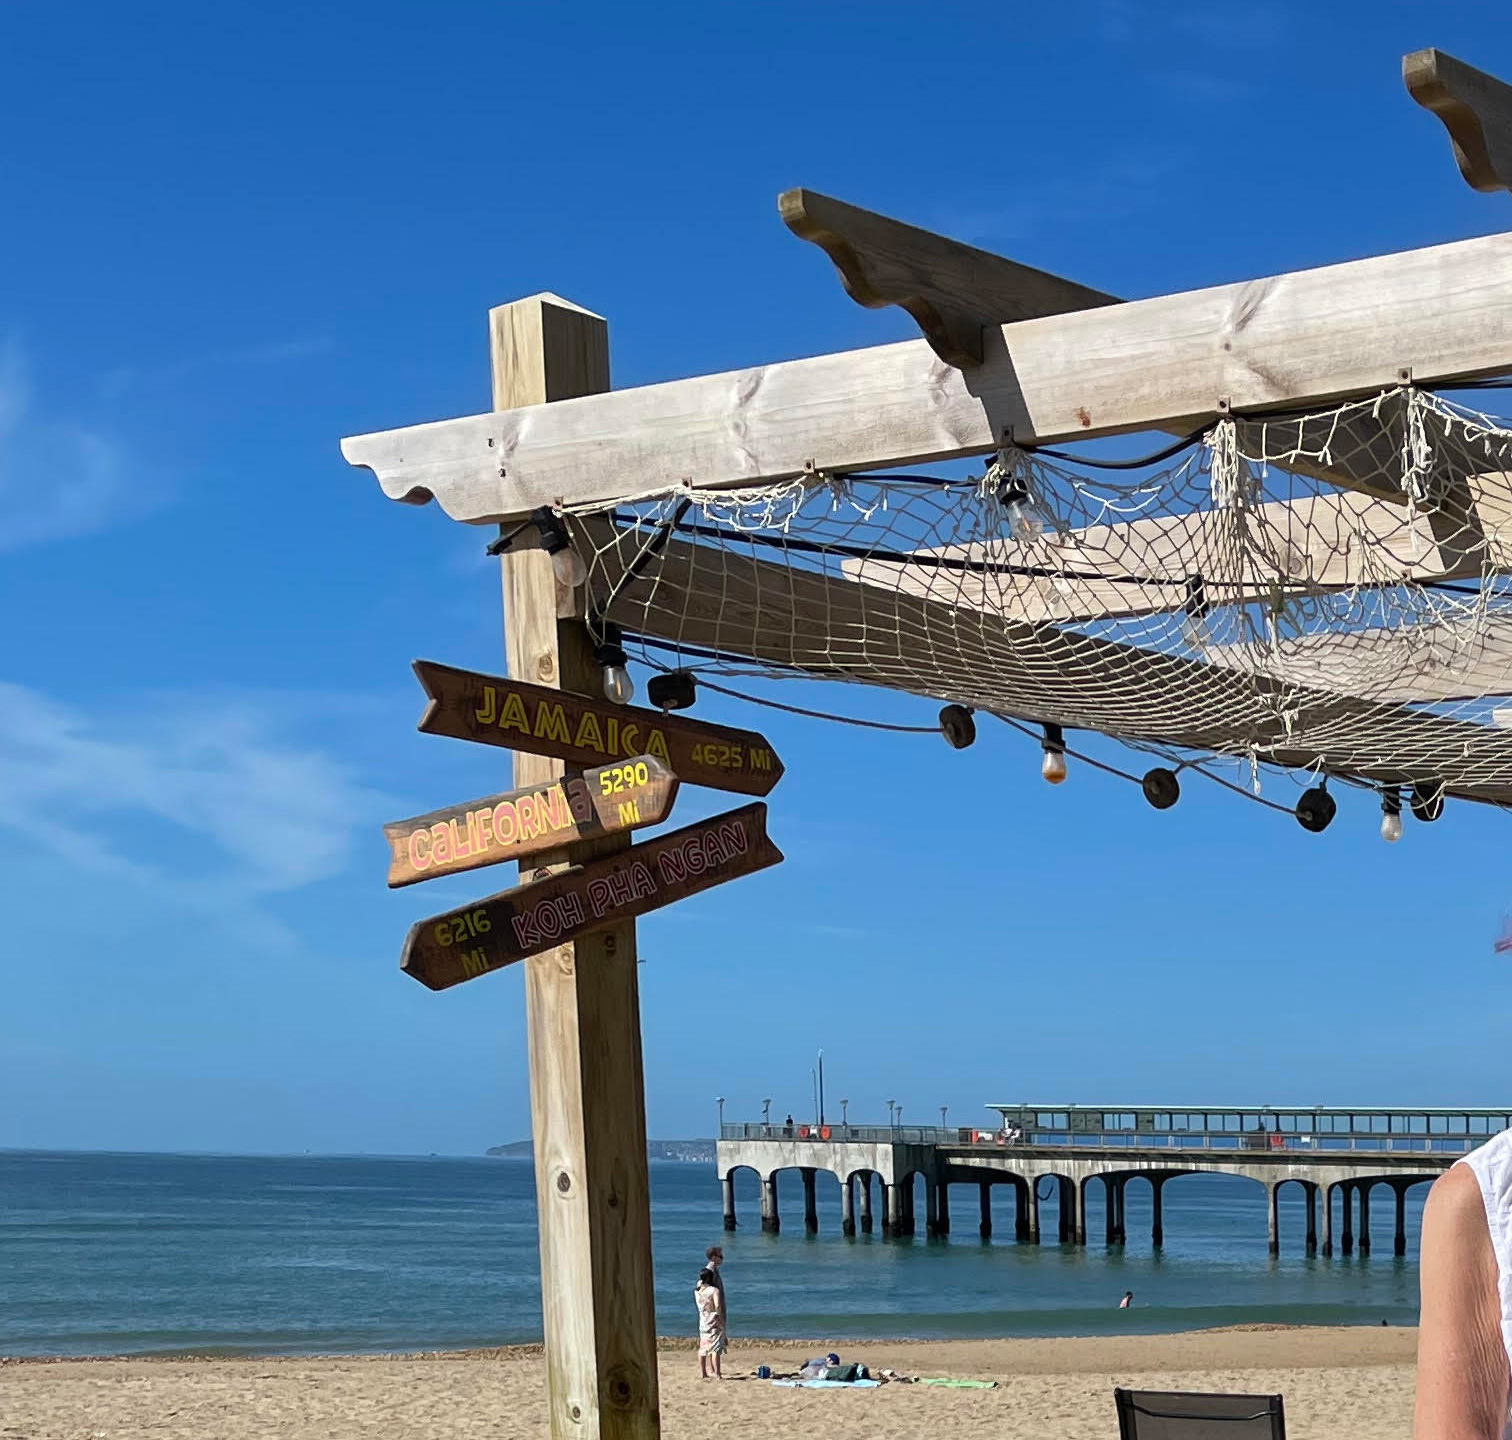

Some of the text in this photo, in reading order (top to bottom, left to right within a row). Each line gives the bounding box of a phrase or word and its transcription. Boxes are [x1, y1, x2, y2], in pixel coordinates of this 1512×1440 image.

[476, 687, 670, 765] JAMAICA
[689, 743, 744, 768] 4625
[599, 762, 649, 796] 5290
[513, 822, 747, 948] KOH PHA NGAN
[434, 909, 492, 947] 6216
